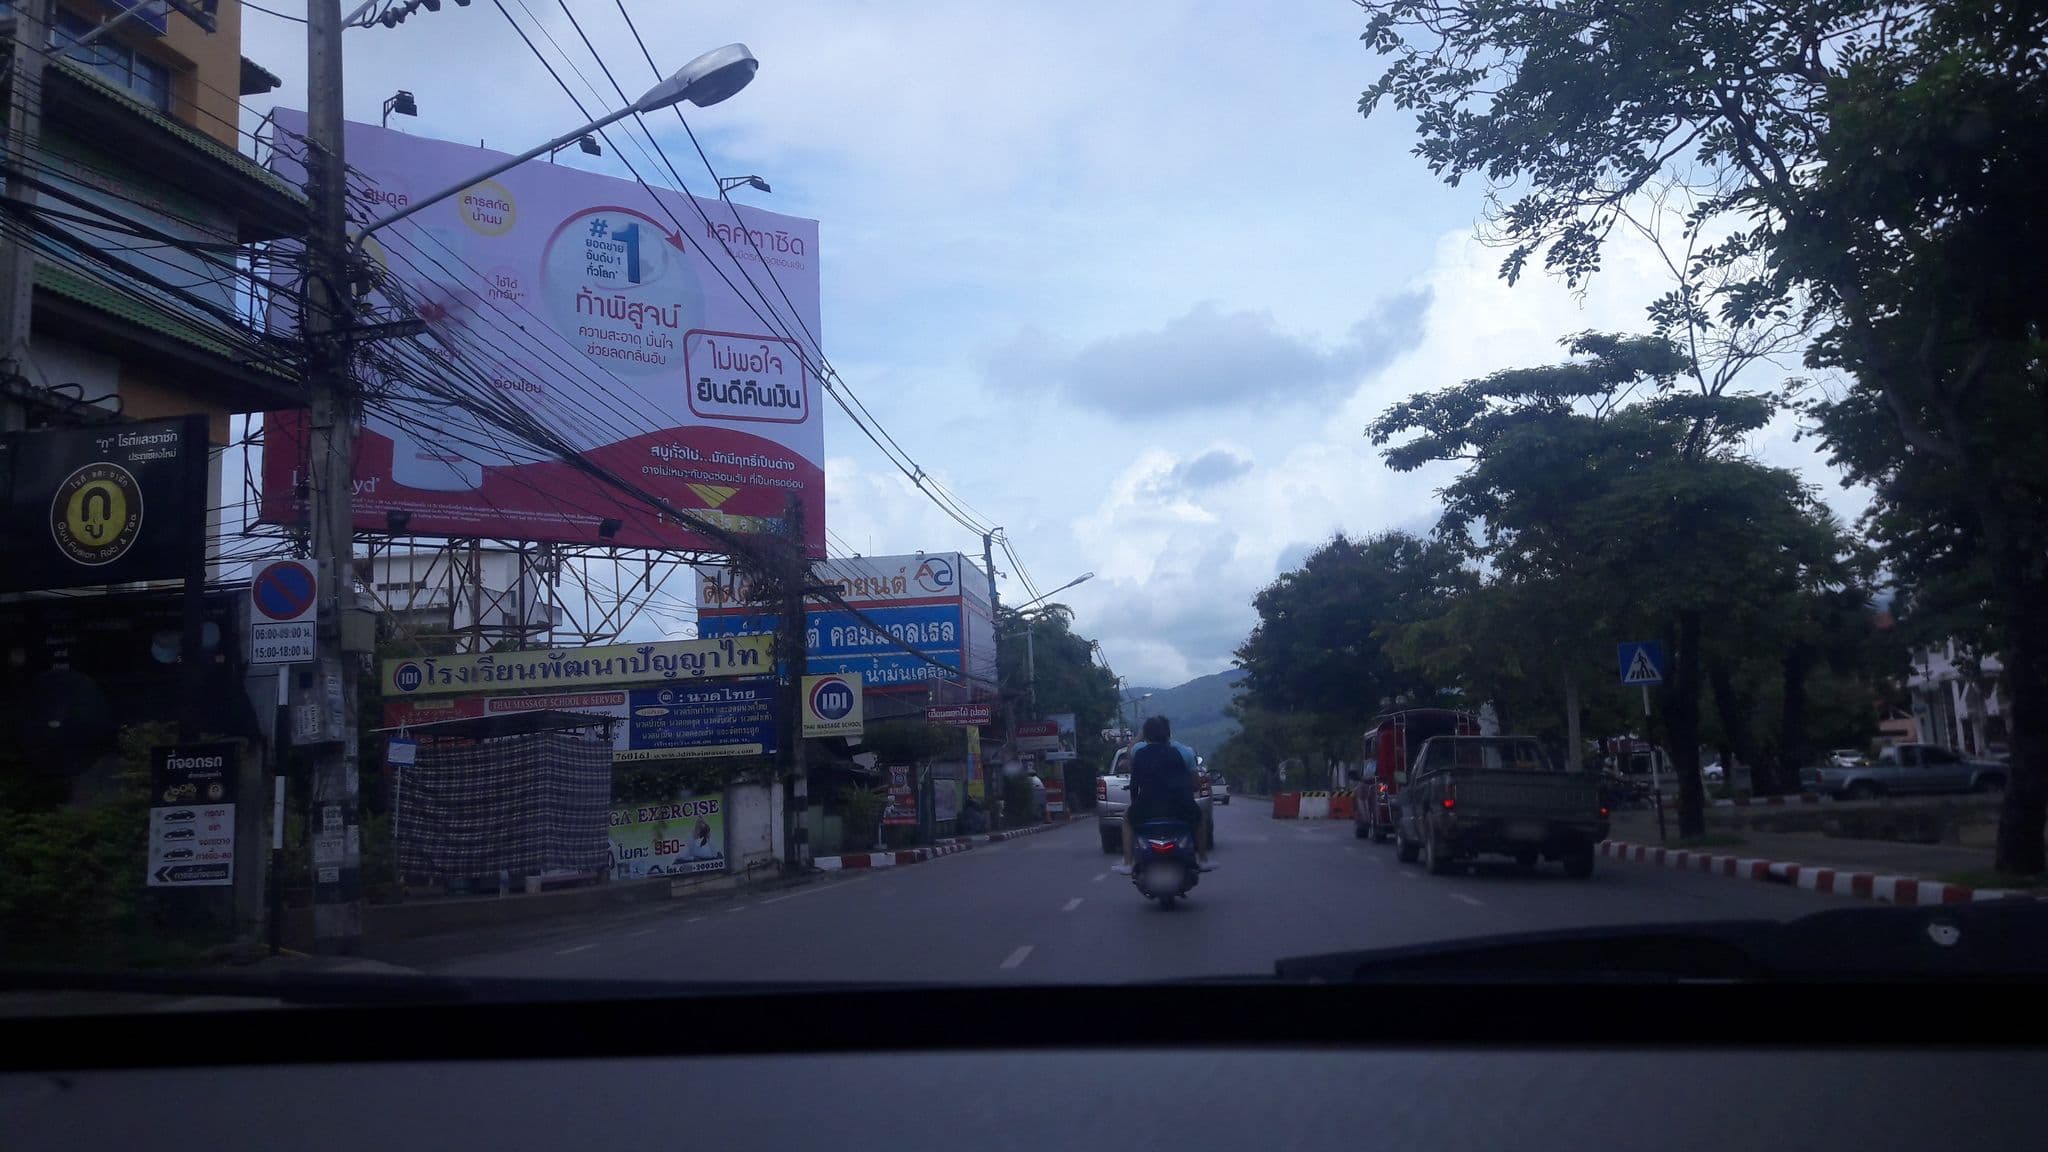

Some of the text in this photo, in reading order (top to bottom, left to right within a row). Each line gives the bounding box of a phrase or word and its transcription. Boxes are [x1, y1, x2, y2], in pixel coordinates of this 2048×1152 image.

[464, 194, 510, 212] สารสกัด
[472, 208, 502, 225] น้ำนม
[586, 239, 624, 253] ยอดขาย
[587, 250, 613, 263] อันดับ
[576, 286, 681, 329] ท้าพิสูจน์
[579, 326, 673, 349] ความสะอาด มั่นใจ
[587, 342, 666, 365] ช่วยลดกลิ่นอับ
[707, 339, 783, 375] ไม่พอใจ
[697, 376, 801, 409] ยินดีคืนเงิน
[255, 646, 300, 657] 15:00-18:00
[401, 672, 418, 685] IDI
[550, 697, 581, 706] SCHOOL
[687, 688, 756, 702] นวดไทย
[822, 692, 847, 710] IDI
[637, 799, 720, 823] EXERCISE
[618, 842, 649, 860] โยคะ
